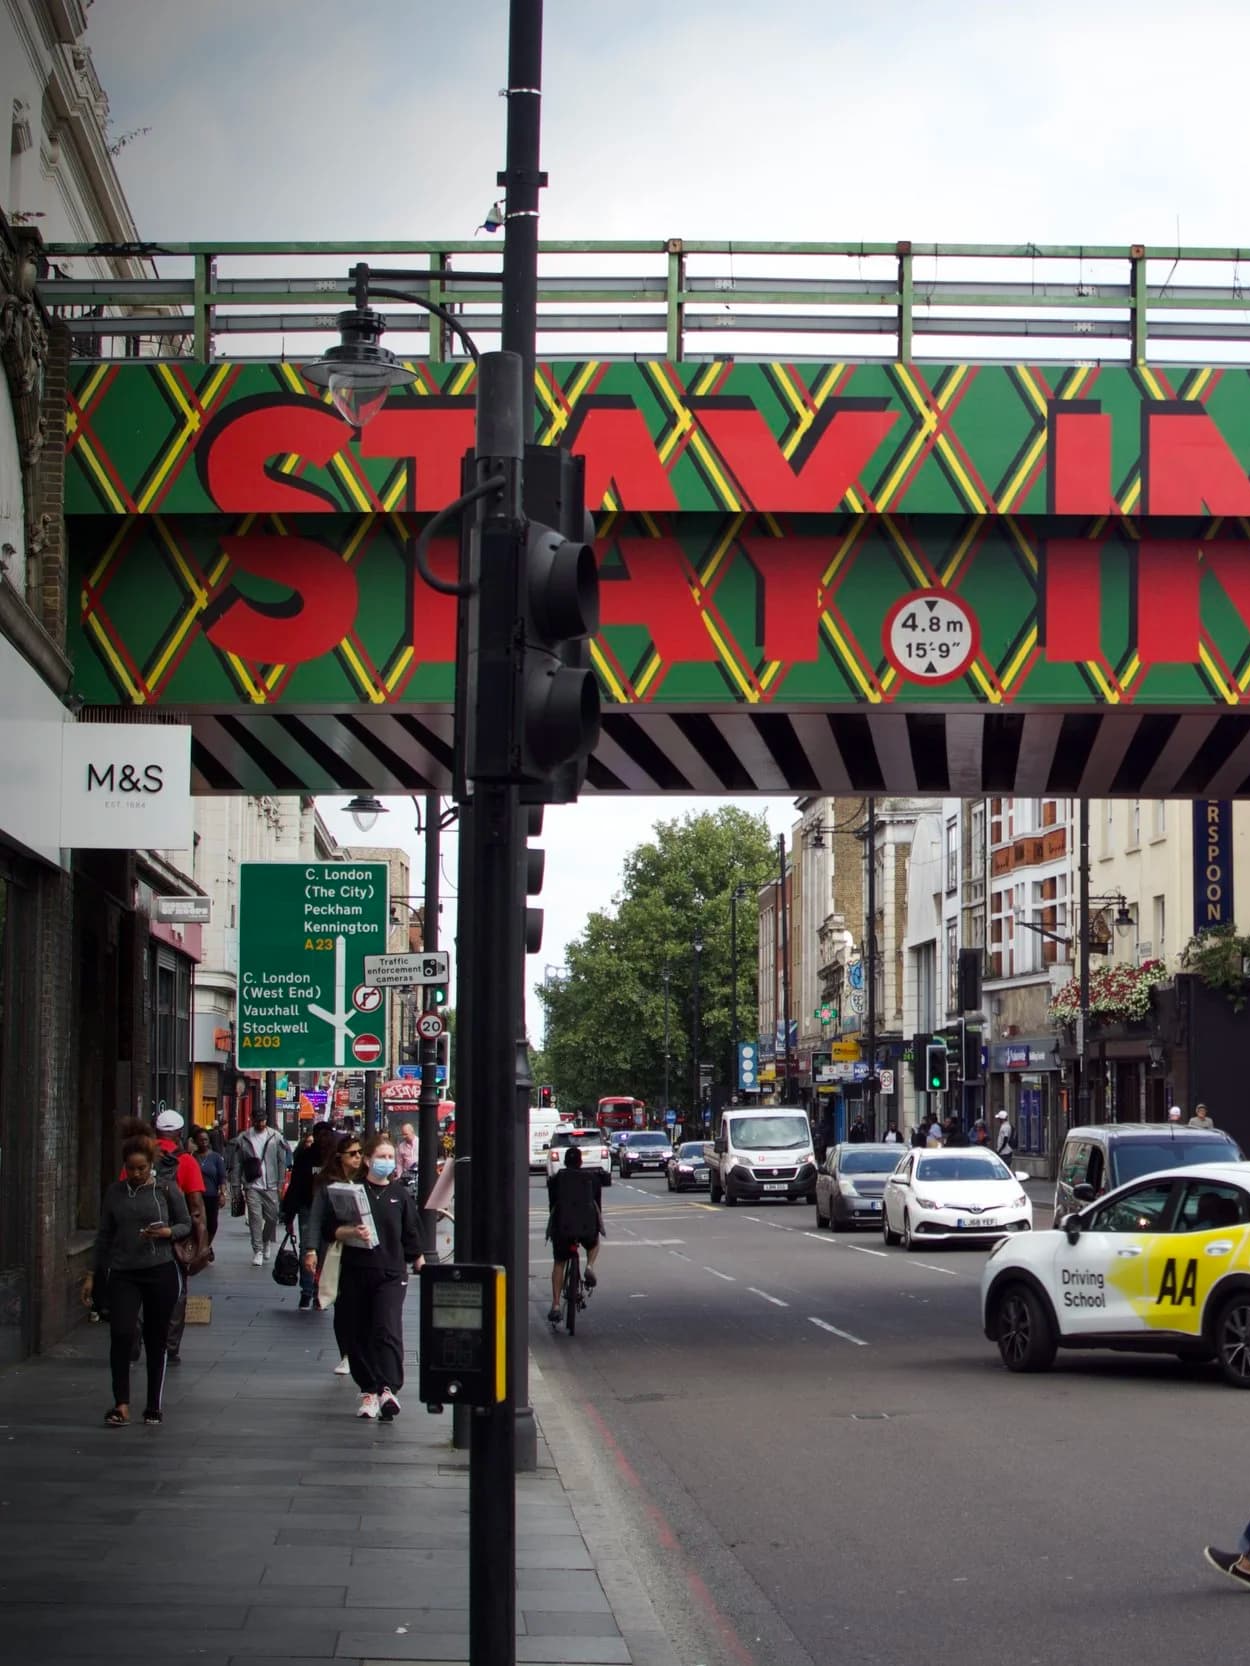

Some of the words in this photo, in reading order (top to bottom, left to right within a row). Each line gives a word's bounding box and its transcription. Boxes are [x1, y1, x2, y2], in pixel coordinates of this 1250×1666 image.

[200, 394, 901, 663] STAY
[901, 612, 941, 632] 4.8
[946, 620, 963, 632] m
[87, 763, 164, 793] M&S
[1206, 800, 1221, 921] RSPOON
[305, 868, 319, 880] C.
[324, 868, 373, 880] London
[304, 885, 336, 898] (The
[340, 885, 375, 899] City)
[304, 903, 362, 915] Peckham
[303, 921, 379, 935] Kennington
[379, 957, 409, 967] Traffic
[367, 965, 422, 976] enforcement
[243, 971, 257, 984] C.
[262, 971, 311, 984] London
[375, 974, 414, 984] cameras
[243, 987, 284, 999] (West
[288, 987, 322, 999] End)
[243, 1004, 299, 1016] Vauxhall
[243, 1022, 309, 1034] Stockwell
[422, 1020, 441, 1032] 20
[1062, 1269, 1105, 1289] Driving
[1155, 1257, 1198, 1307] AA
[1063, 1291, 1107, 1308] School
